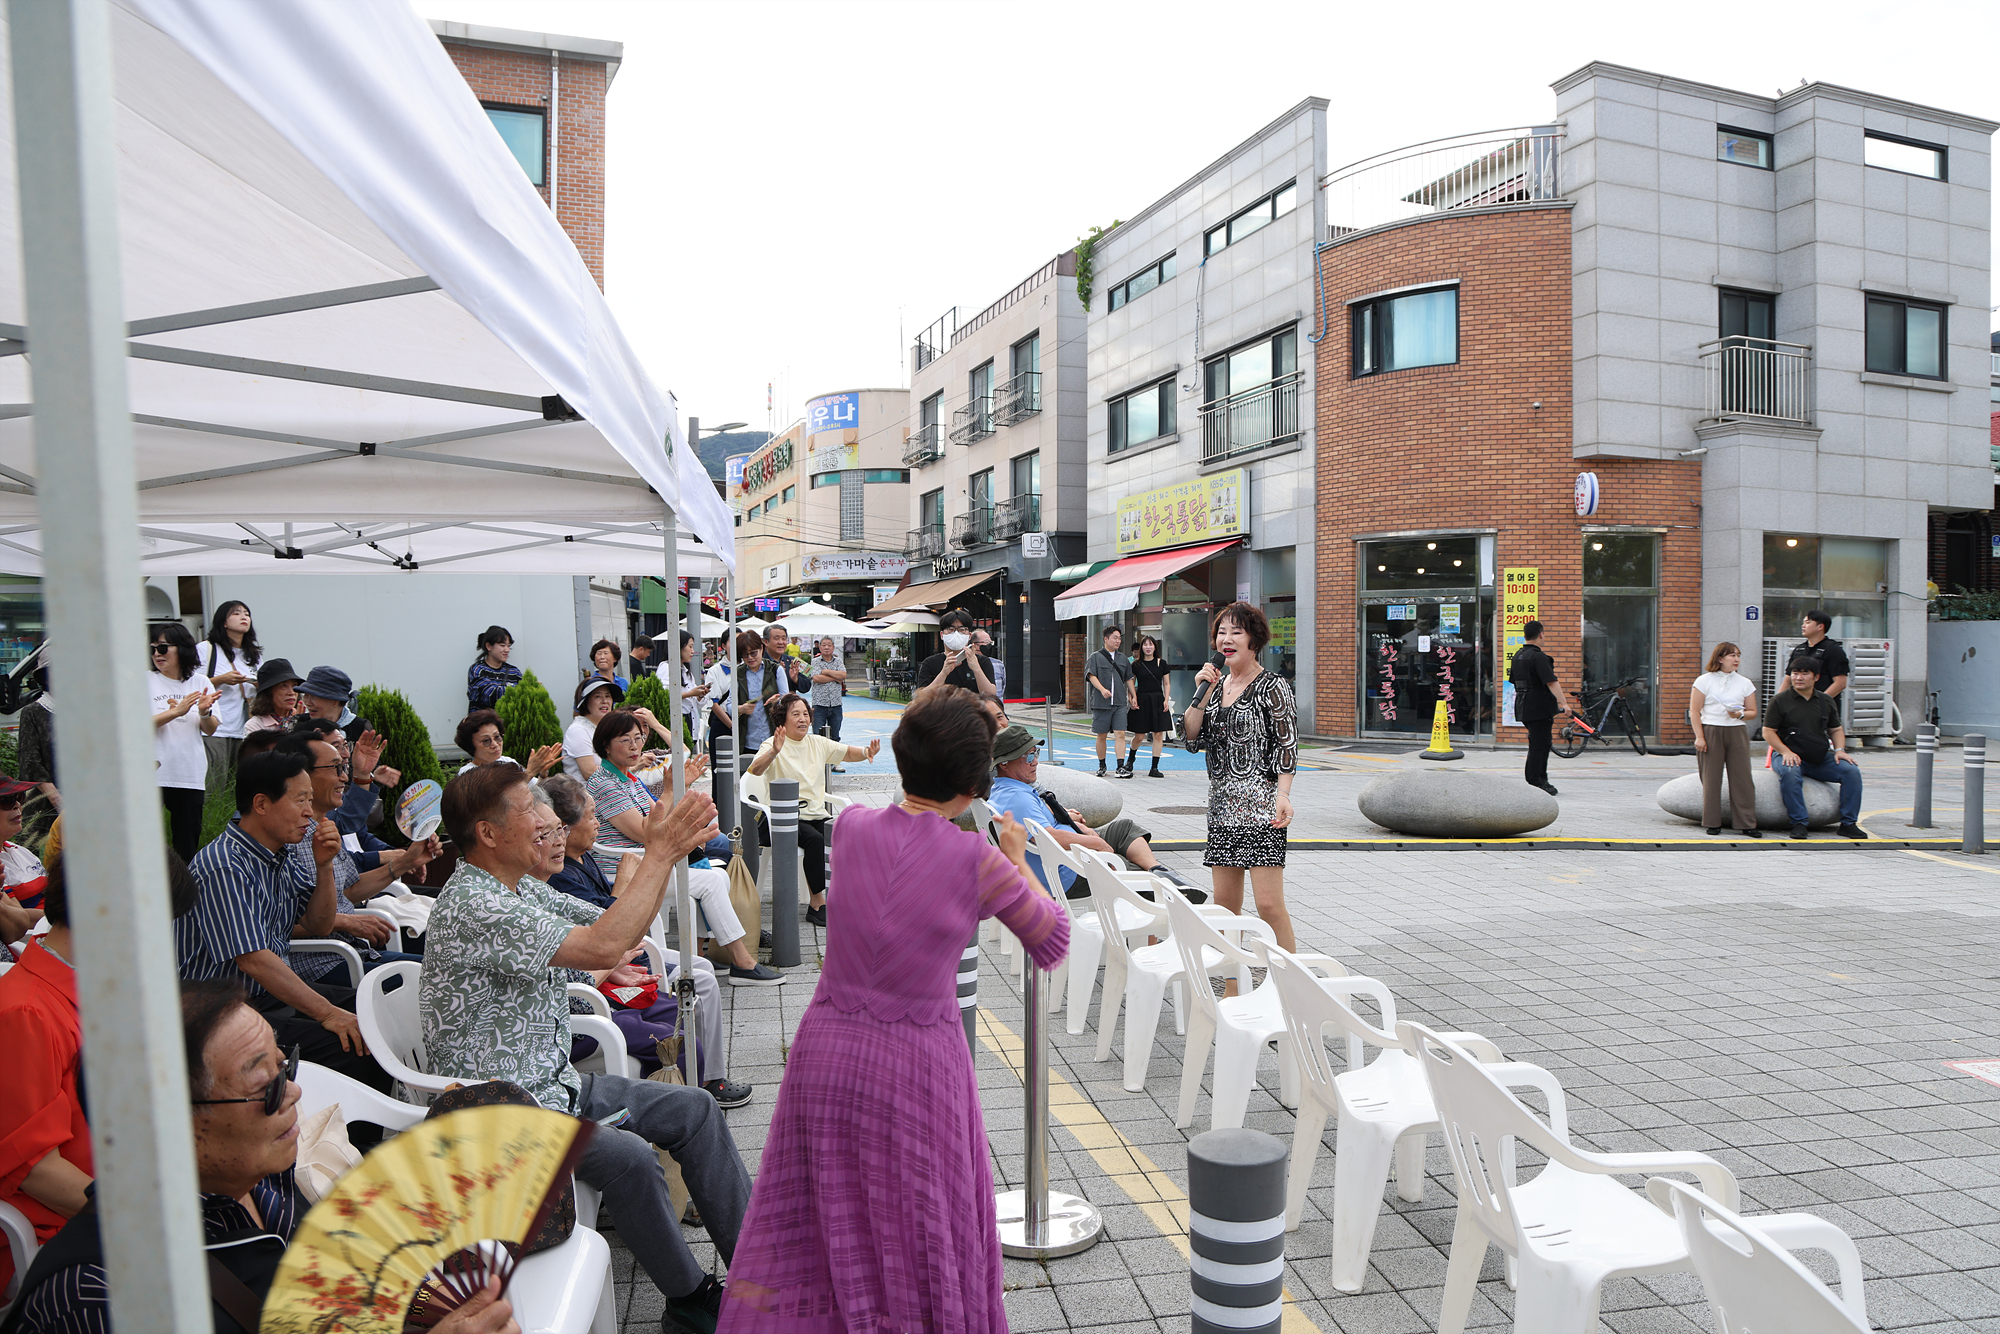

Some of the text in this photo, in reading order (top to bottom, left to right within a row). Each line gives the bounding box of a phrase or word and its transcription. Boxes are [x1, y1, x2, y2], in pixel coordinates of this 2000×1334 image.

[1144, 493, 1207, 538] 한국통닭
[821, 557, 906, 570] 엄마손 가마솥 순두부
[1506, 584, 1536, 594] 10:00
[754, 598, 779, 611] 두부
[1506, 615, 1536, 625] 22:00
[1379, 644, 1398, 721] 한국통닭
[153, 694, 168, 702] MON
